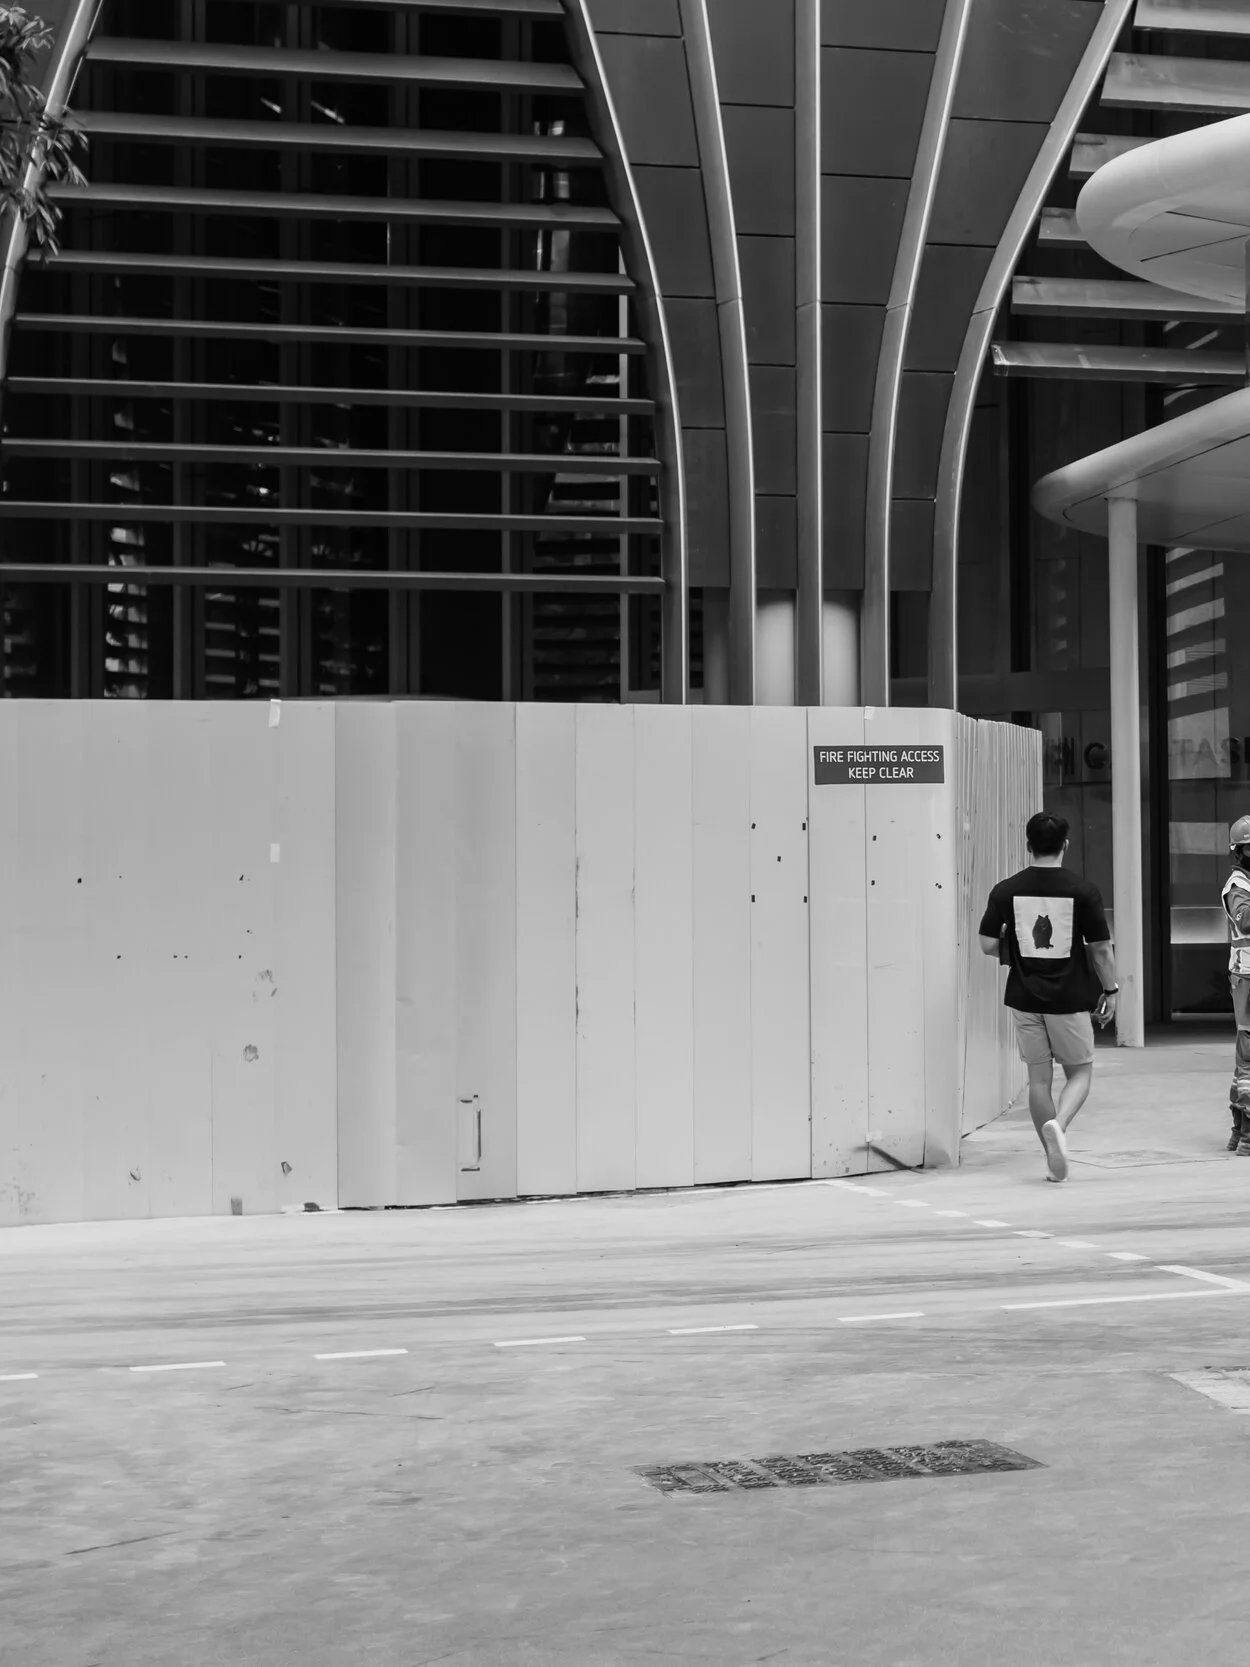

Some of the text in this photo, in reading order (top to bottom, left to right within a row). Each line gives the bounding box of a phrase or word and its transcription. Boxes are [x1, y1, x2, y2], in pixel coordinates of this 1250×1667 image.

[819, 750, 940, 763] FIRE FIGHTING ACCESS
[848, 766, 914, 779] KEEP CLEAR
